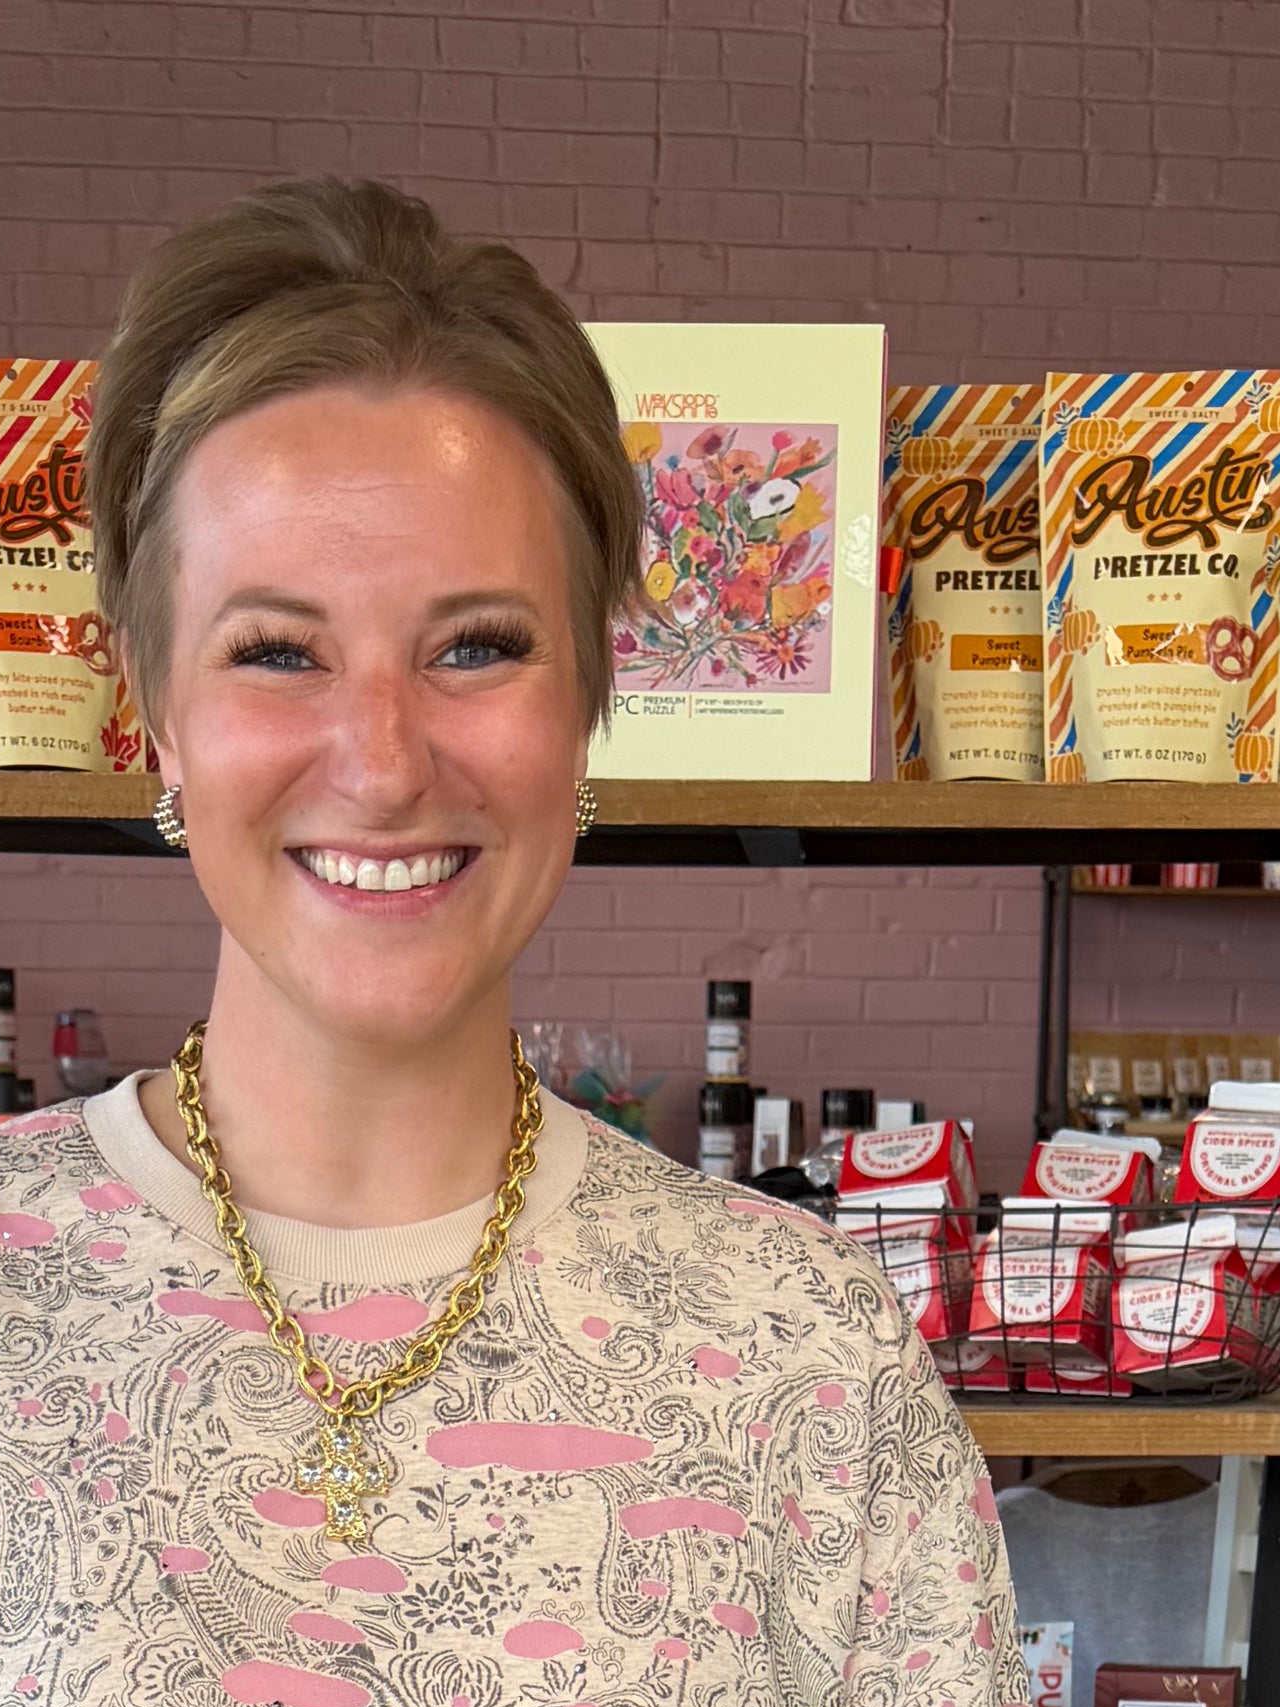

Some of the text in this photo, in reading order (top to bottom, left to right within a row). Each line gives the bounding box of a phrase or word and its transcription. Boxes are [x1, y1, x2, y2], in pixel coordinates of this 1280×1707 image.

[19, 403, 48, 413] SALTY
[1148, 410, 1179, 419] SWEET
[1191, 411, 1220, 419] SALTY
[978, 428, 1009, 437] SWEET
[1071, 447, 1273, 548] Austin
[66, 550, 95, 573] CO
[1094, 553, 1239, 580] PRETZEL CO.
[935, 570, 1041, 592] PRETZEL
[987, 639, 1022, 650] Sweet
[1176, 647, 1194, 658] Pie
[643, 696, 686, 705] PREMIUM
[643, 705, 676, 715] PUZZLE
[10, 736, 29, 748] WT.
[32, 736, 39, 747] 6
[41, 737, 57, 748] OZ
[949, 749, 970, 761] NET
[972, 749, 990, 759] WT.
[993, 750, 1000, 759] 6
[1003, 750, 1016, 761] OZ
[1103, 749, 1121, 760] NET
[1124, 749, 1143, 760] WT.
[1145, 750, 1152, 759] 6
[1155, 750, 1169, 760] OZ
[1203, 1136, 1276, 1149] CIDER SPICES
[1200, 1152, 1237, 1187] ORIGINAL
[1241, 1155, 1272, 1185] BLEND
